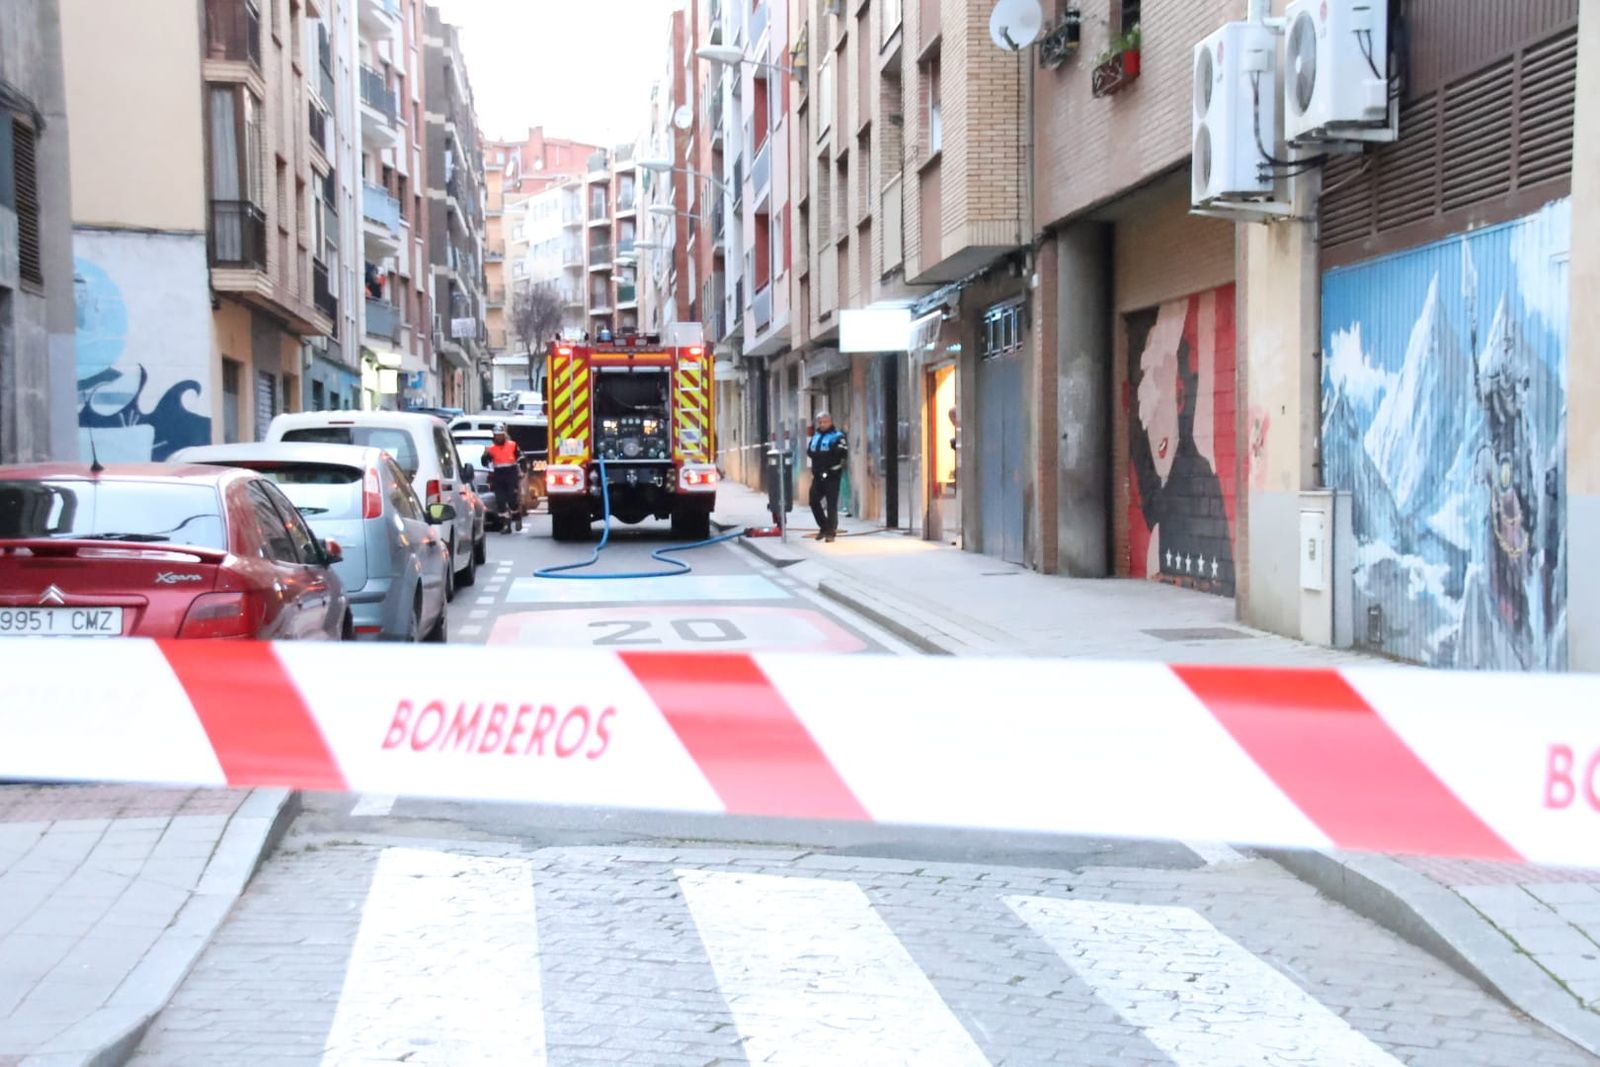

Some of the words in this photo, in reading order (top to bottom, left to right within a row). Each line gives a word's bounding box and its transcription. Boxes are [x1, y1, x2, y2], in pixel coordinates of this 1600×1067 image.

[0, 610, 54, 631] 9951
[71, 610, 113, 631] CMZ
[587, 618, 748, 645] 20
[380, 698, 617, 760] BOMBEROS
